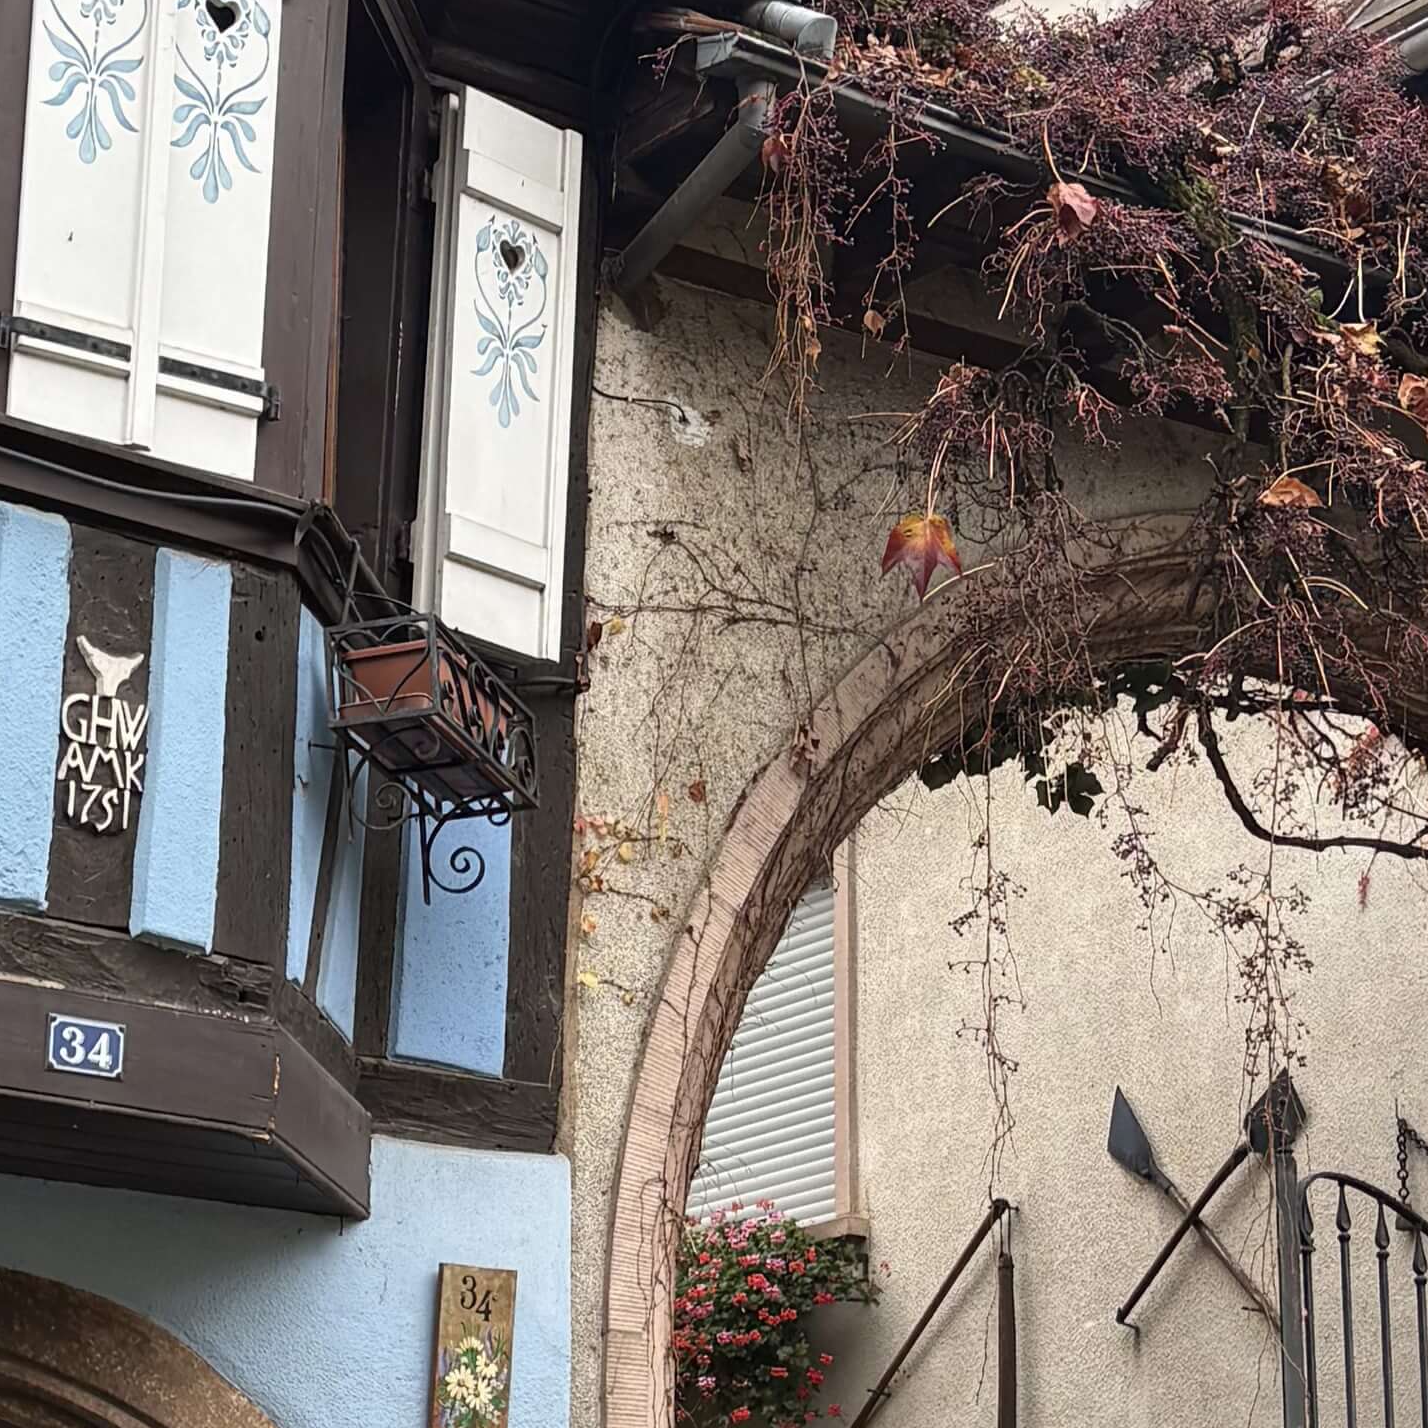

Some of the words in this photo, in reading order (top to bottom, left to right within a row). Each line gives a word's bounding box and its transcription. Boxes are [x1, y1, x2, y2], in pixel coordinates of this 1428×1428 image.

[61, 693, 149, 750] GHW
[57, 741, 145, 792] AMK
[59, 1026, 113, 1070] 34
[460, 1275, 493, 1322] 34
